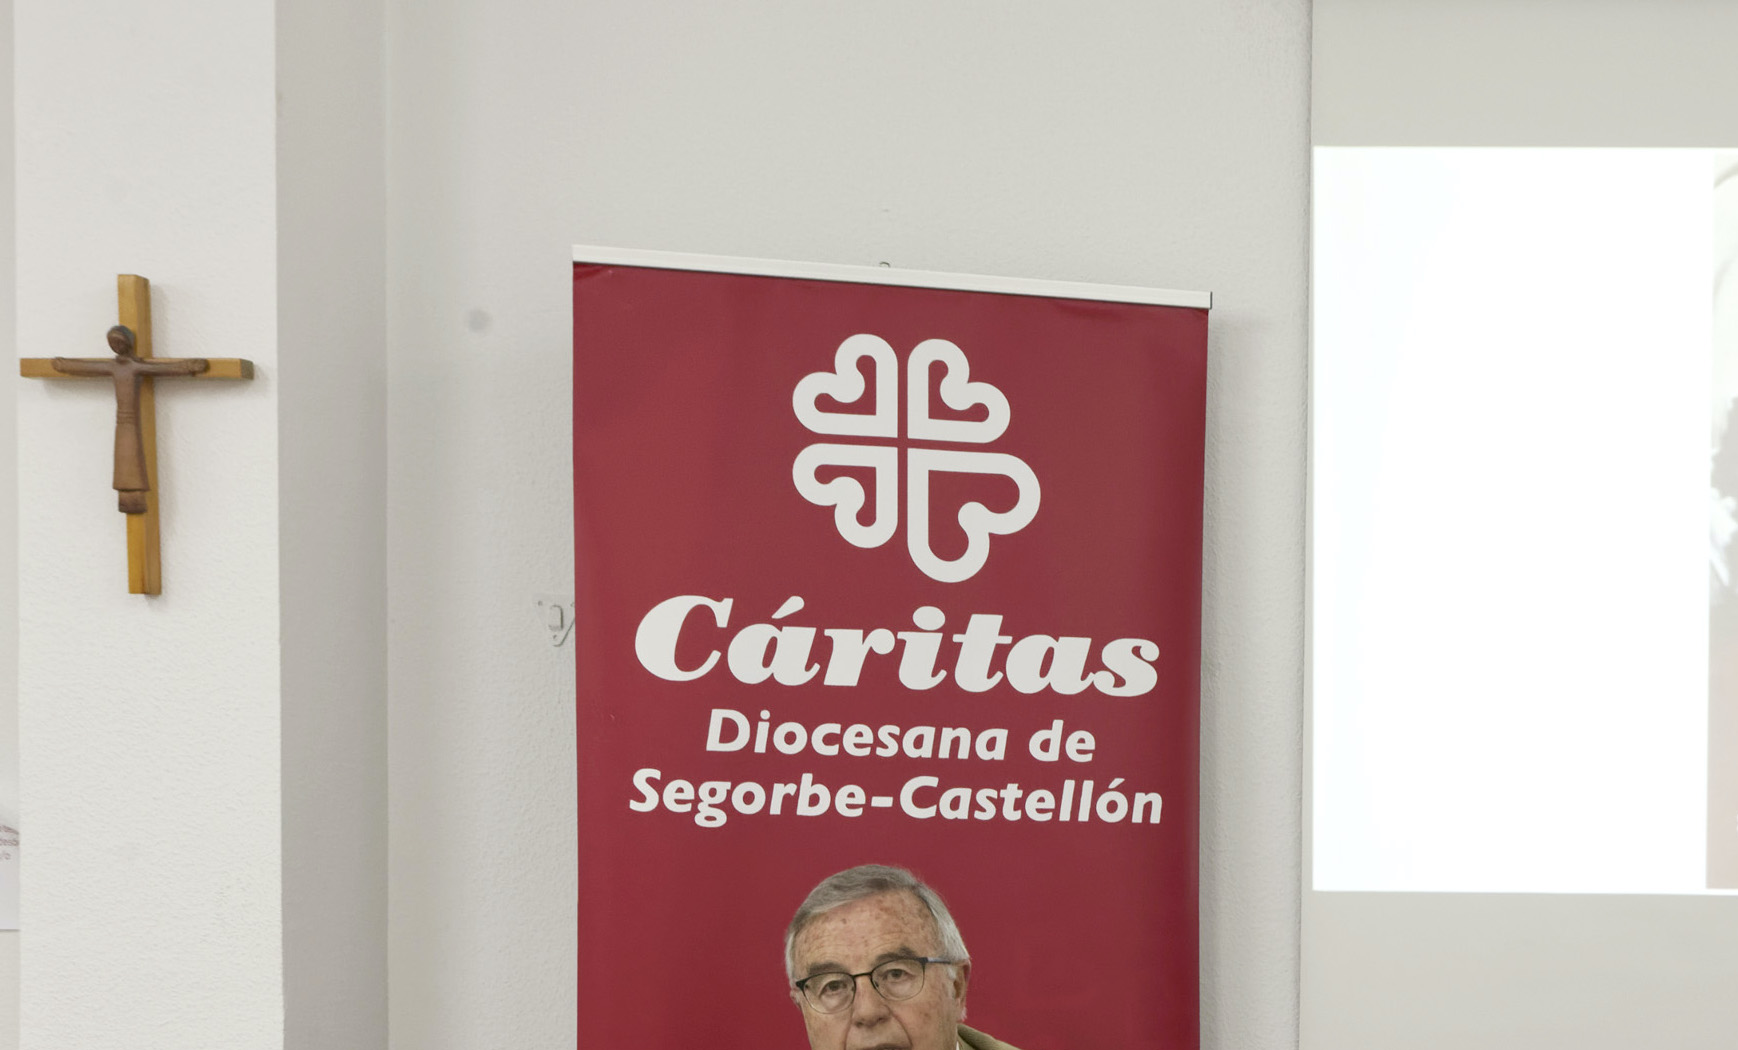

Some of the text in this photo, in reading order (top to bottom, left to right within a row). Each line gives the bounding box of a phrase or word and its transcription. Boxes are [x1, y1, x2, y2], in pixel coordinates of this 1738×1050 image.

[635, 595, 1160, 698] Cáritas
[706, 709, 1096, 762] Diocesana de
[629, 768, 1163, 828] Segorbe-Castellón
